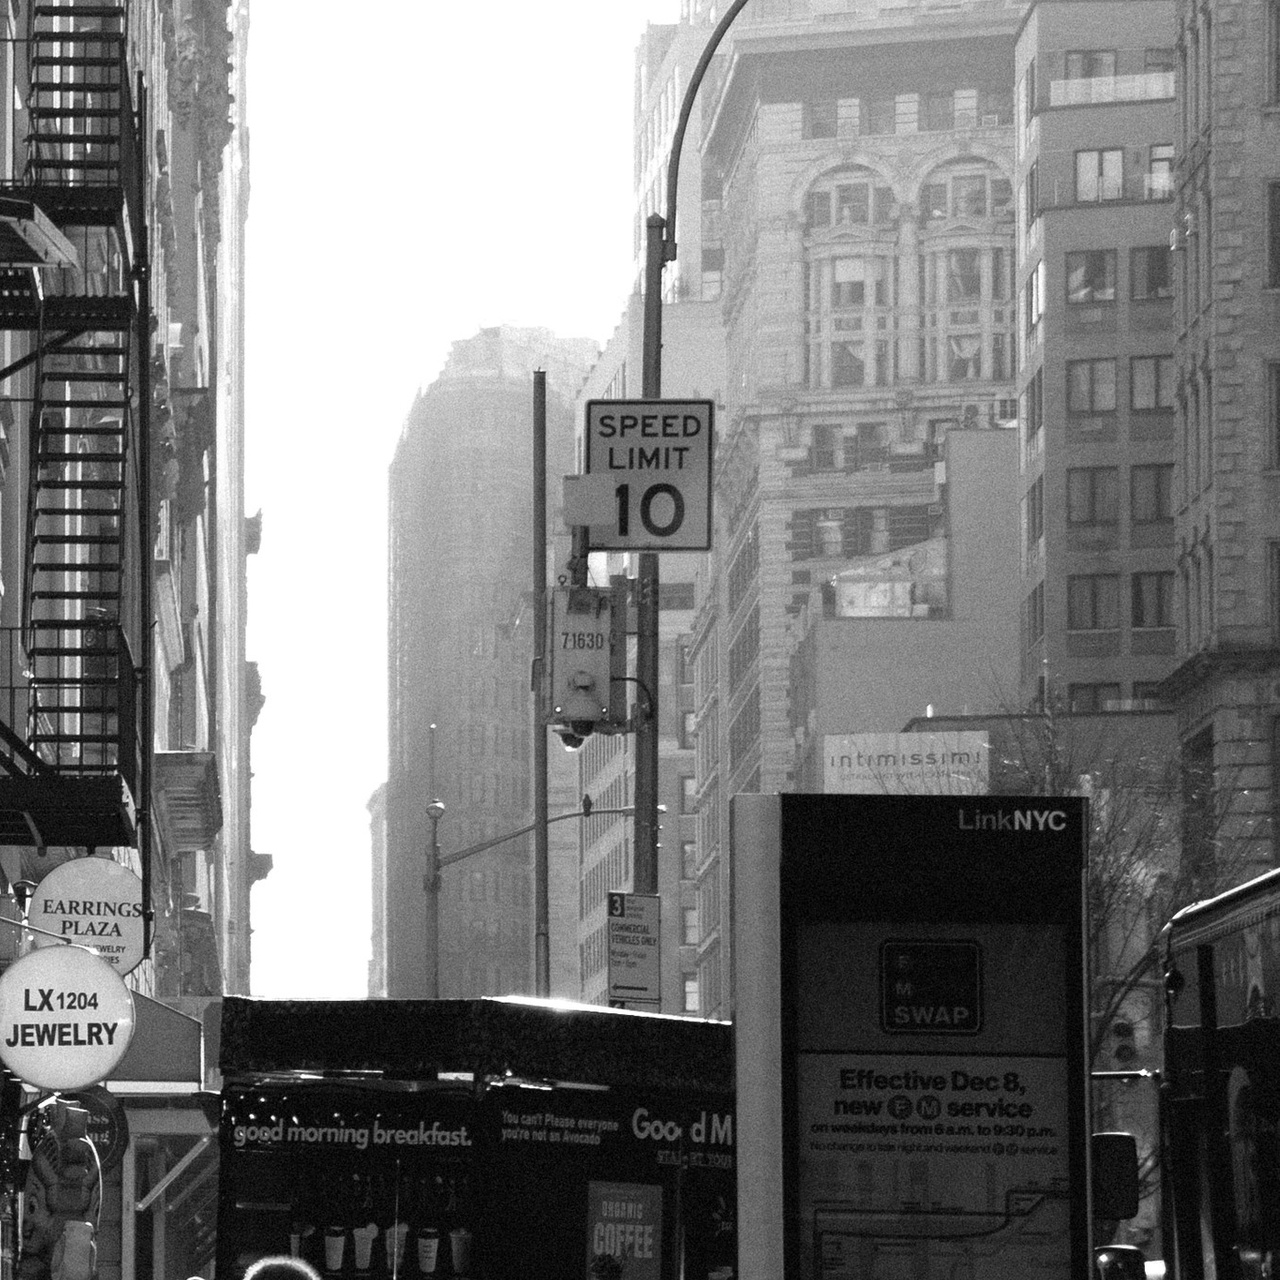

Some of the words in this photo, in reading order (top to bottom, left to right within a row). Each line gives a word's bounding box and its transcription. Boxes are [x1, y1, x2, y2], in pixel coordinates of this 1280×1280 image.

[599, 414, 701, 438] SPEED
[608, 446, 690, 470] LIMIT
[615, 482, 685, 537] 10
[561, 632, 604, 650] 71630
[830, 750, 980, 768] intimissimi
[958, 809, 1067, 832] LinkNYC
[42, 898, 143, 918] EARRINGS
[62, 920, 123, 938] PLAZA
[895, 983, 912, 996] M
[893, 1006, 970, 1025] SWAP
[5, 1022, 119, 1048] JEWELRY
[839, 1069, 946, 1091] Effective
[951, 1070, 1000, 1092] Dec
[1003, 1071, 1027, 1096] 8,
[833, 1100, 883, 1116] new
[947, 1098, 1033, 1118] service
[501, 1110, 520, 1125] You
[544, 1113, 576, 1128] Please
[577, 1119, 619, 1133] everyone
[811, 1124, 828, 1135] on
[831, 1122, 898, 1137] weekdays
[900, 1123, 932, 1135] from
[934, 1123, 944, 1135] 6
[946, 1125, 974, 1135] a.m.
[977, 1124, 991, 1136] to
[993, 1124, 1024, 1137] 9:30
[1026, 1126, 1056, 1138] p.m.
[234, 1117, 284, 1147] good
[287, 1120, 369, 1150] morning
[373, 1120, 473, 1146] breakfast.
[531, 1130, 548, 1142] not
[562, 1130, 601, 1146] Avocado
[593, 1221, 654, 1259] COFFEE
